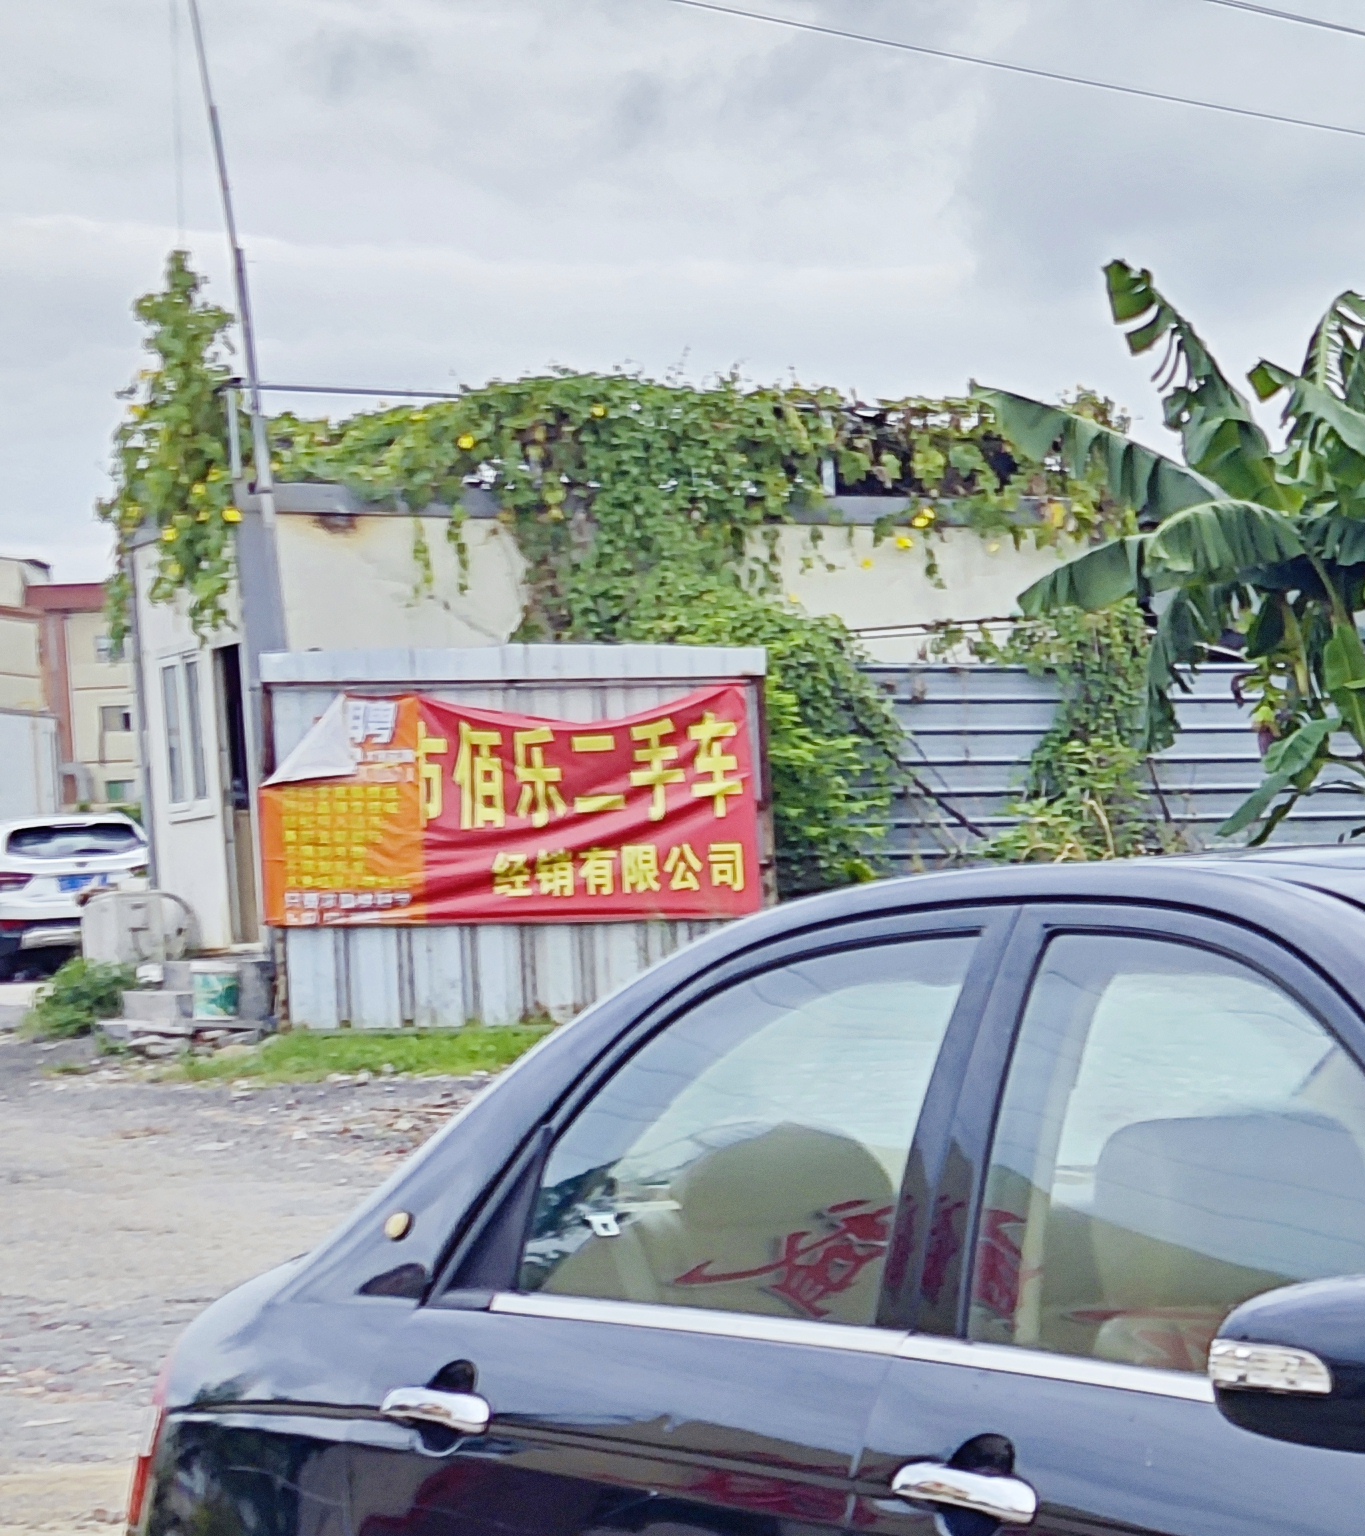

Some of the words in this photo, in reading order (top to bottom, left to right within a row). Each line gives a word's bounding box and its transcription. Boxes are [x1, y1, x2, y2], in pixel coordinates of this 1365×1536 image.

[492, 842, 745, 897] 经销有限公司
